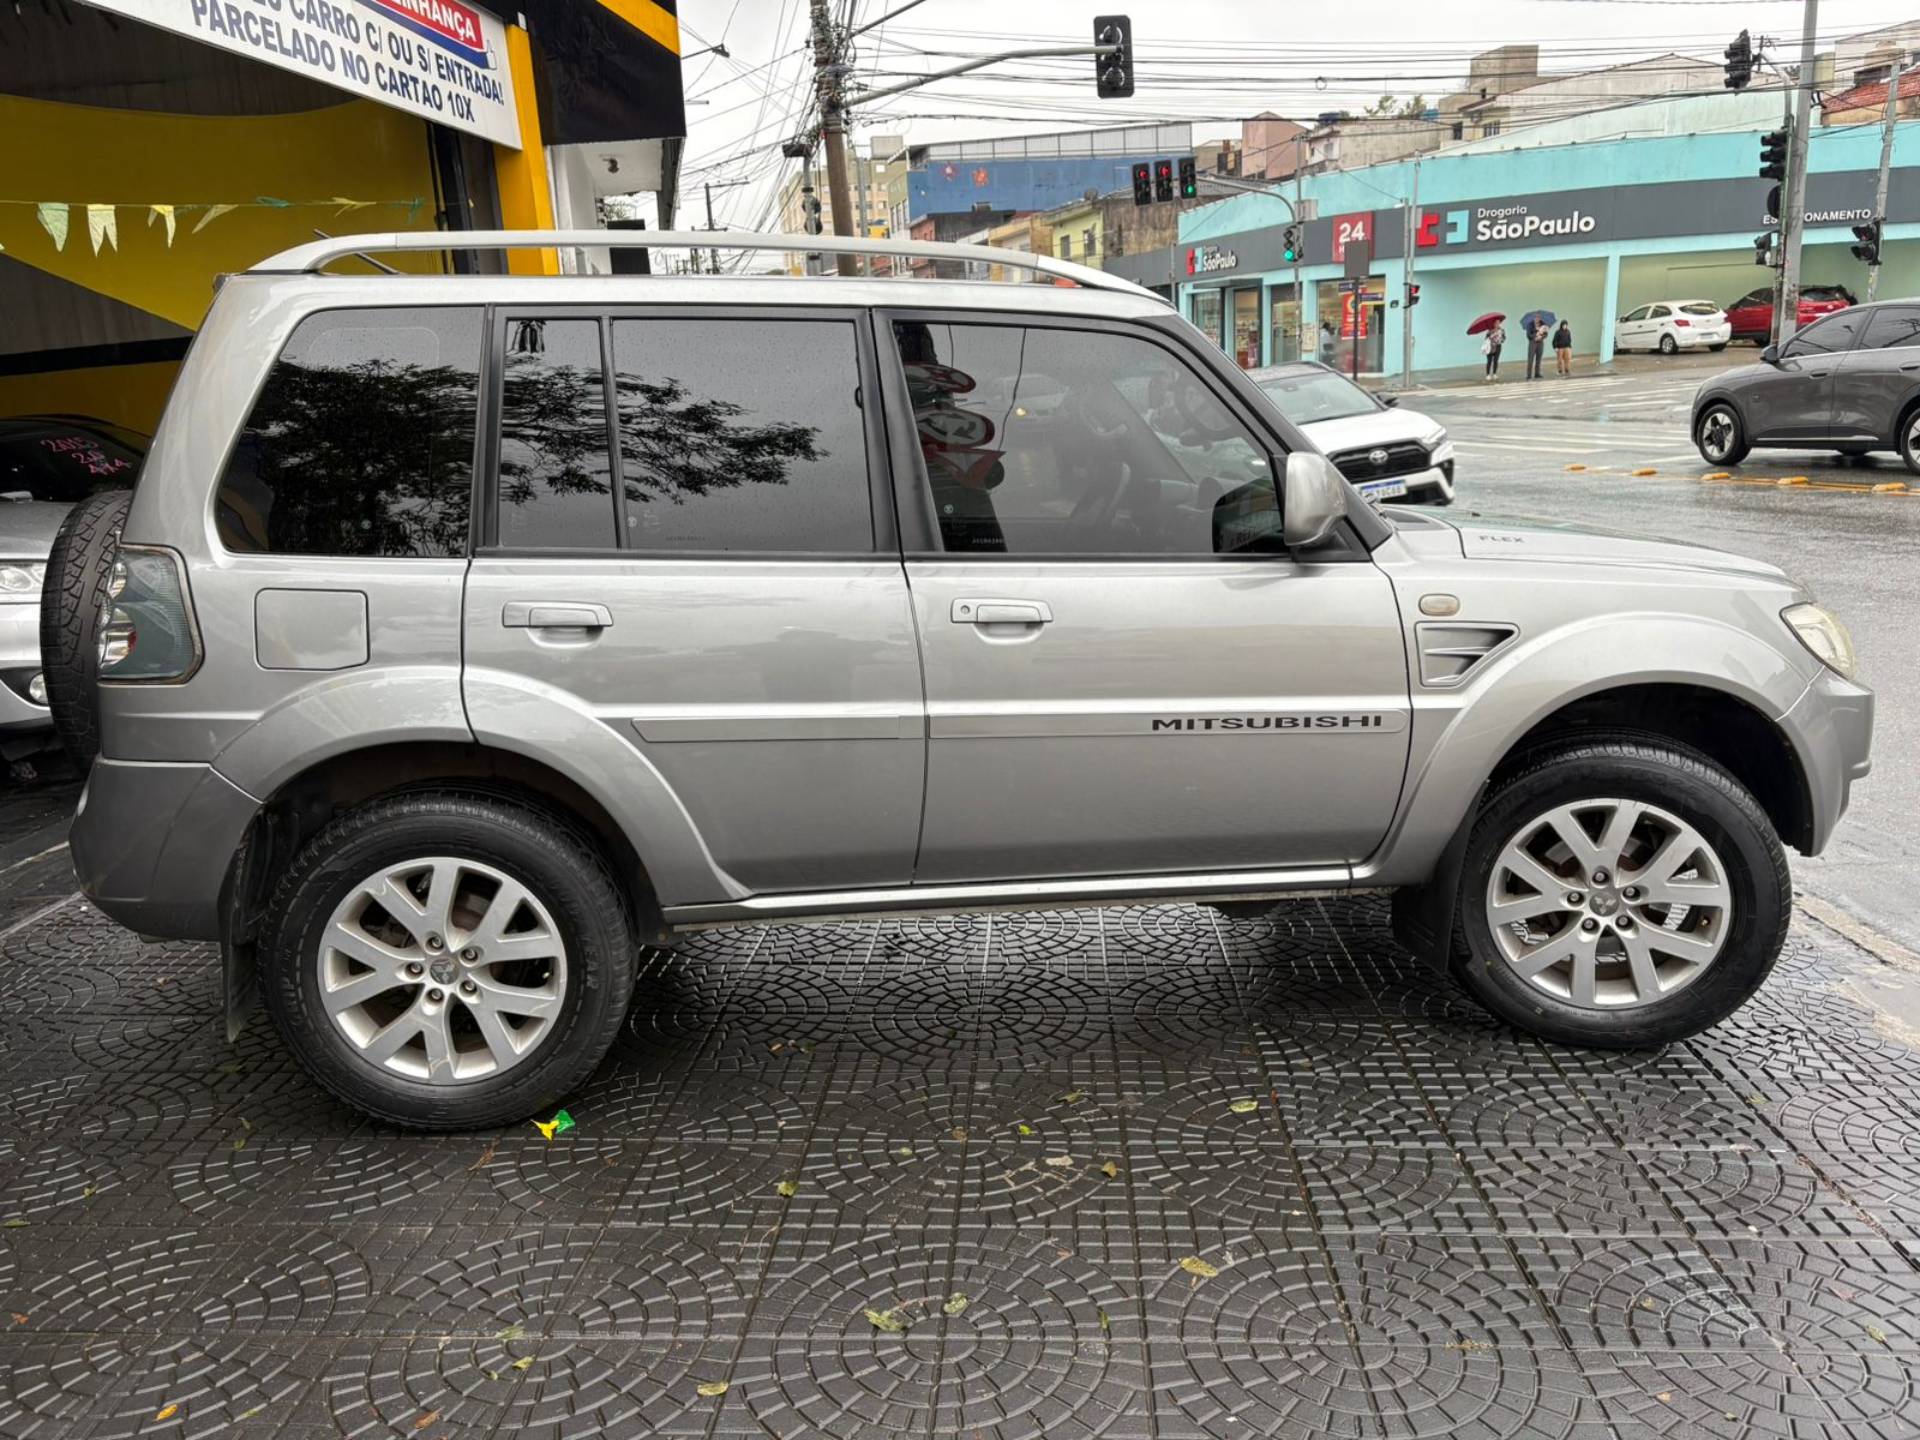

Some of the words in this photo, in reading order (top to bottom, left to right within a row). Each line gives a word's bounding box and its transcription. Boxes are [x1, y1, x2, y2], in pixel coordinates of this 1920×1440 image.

[190, 0, 335, 72] PARCELADO
[340, 47, 370, 85] NO
[447, 90, 475, 122] 10X
[289, 0, 360, 44] CARRO
[366, 21, 383, 54] C/
[388, 31, 413, 66] OU
[417, 44, 432, 74] S/
[434, 52, 505, 105] ENTRADA!
[1477, 205, 1527, 218] Drogaria
[1339, 221, 1365, 242] 24
[1478, 535, 1525, 543] FLEX
[1152, 715, 1381, 731] MITSUBISHI
